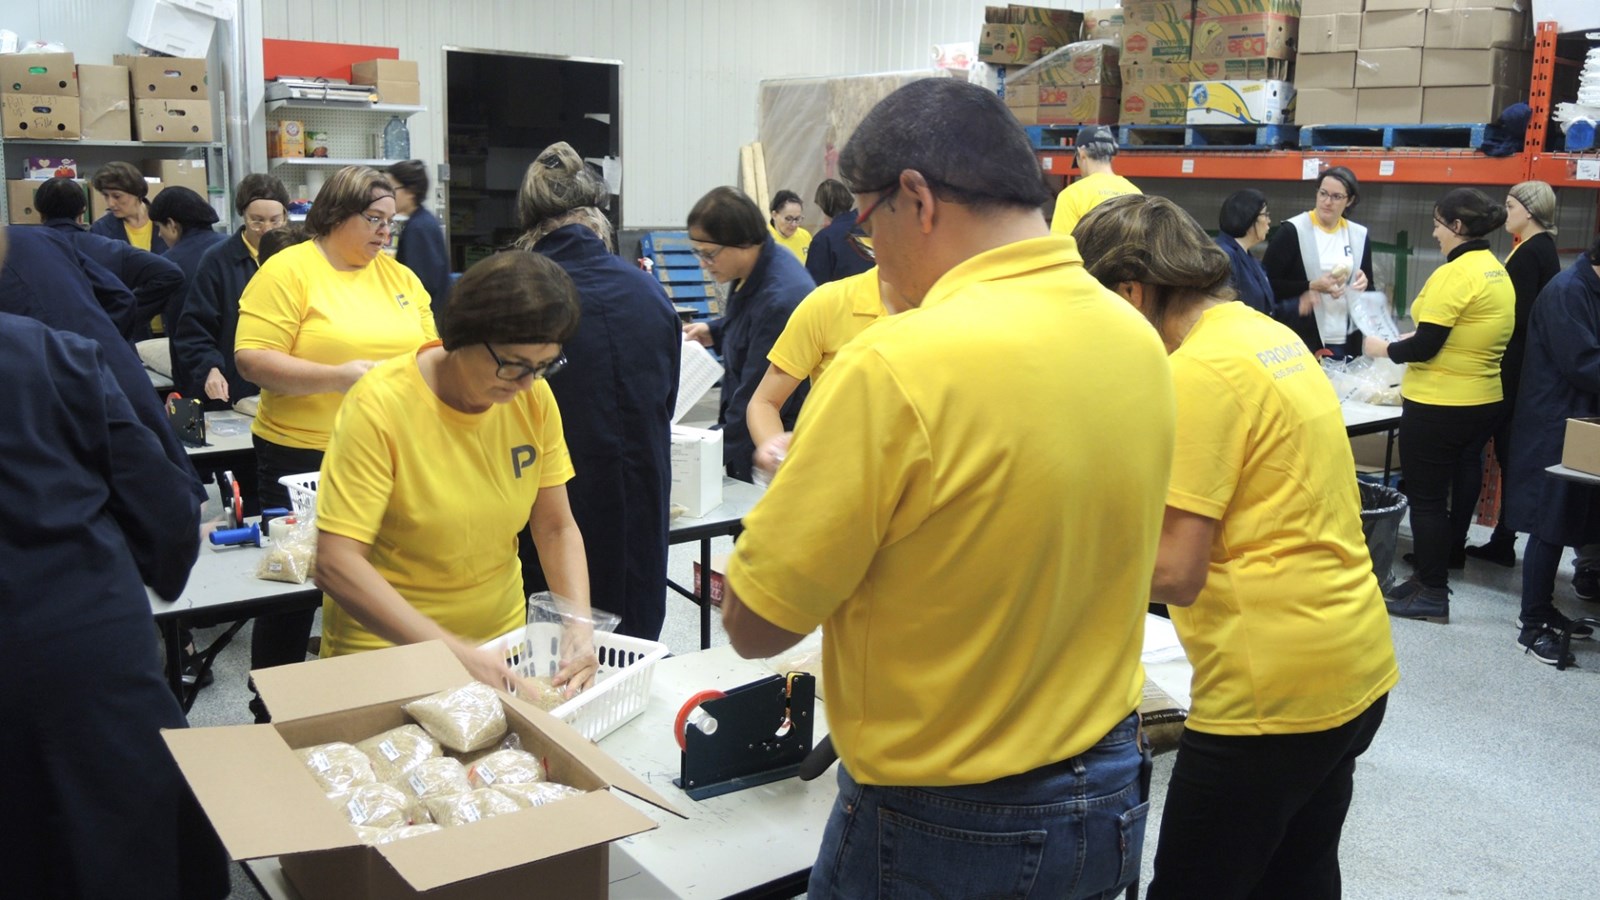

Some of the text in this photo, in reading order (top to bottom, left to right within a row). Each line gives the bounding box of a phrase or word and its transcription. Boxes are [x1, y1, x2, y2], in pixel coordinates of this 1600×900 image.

[1227, 37, 1265, 57] Dole
[1039, 88, 1067, 104] Dole
[510, 444, 537, 479] P
